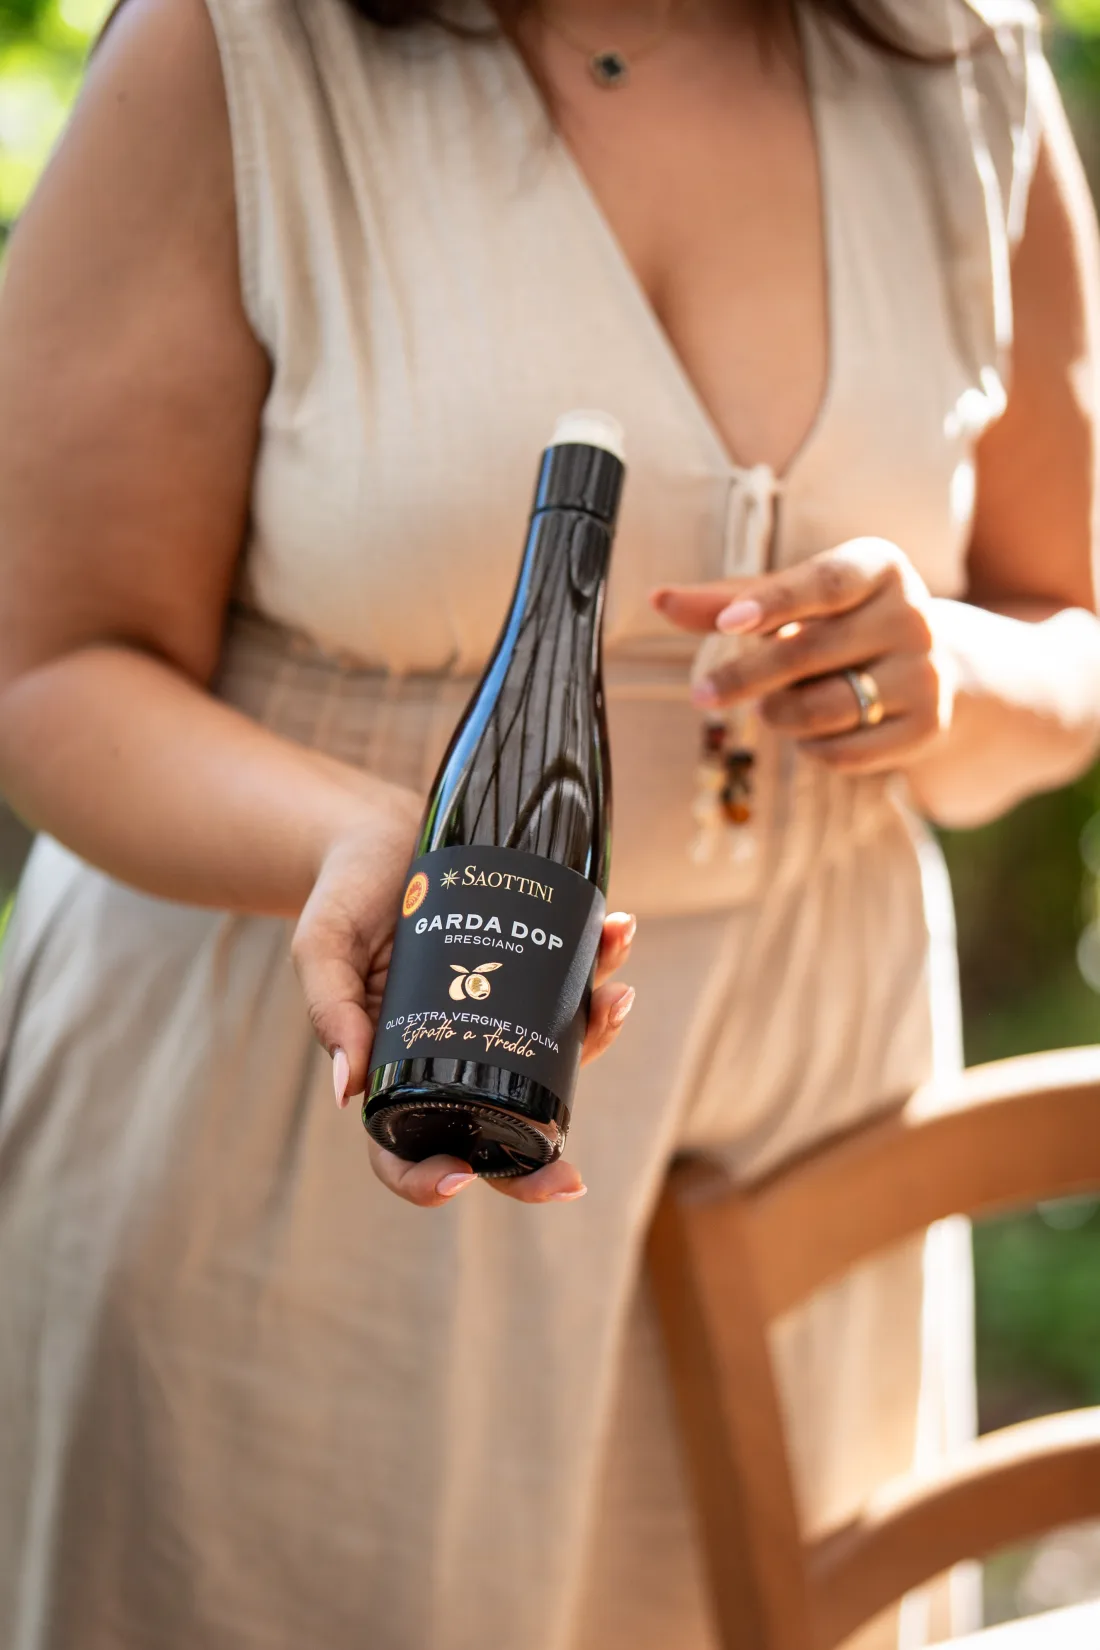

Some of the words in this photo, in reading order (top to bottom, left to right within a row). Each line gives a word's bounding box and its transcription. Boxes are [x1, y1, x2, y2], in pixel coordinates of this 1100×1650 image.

[461, 865, 555, 903] SAOTTINI
[415, 913, 502, 935] GARDA
[511, 921, 564, 951] DOP
[444, 934, 524, 954] BRESCIANO
[386, 1016, 405, 1030] OLIO
[407, 1011, 447, 1023] EXTRA
[452, 1011, 512, 1032] VERGINE
[515, 1025, 528, 1037] DI
[531, 1031, 560, 1054] OLIVA
[402, 1019, 457, 1050] Estratto
[463, 1029, 477, 1041] a
